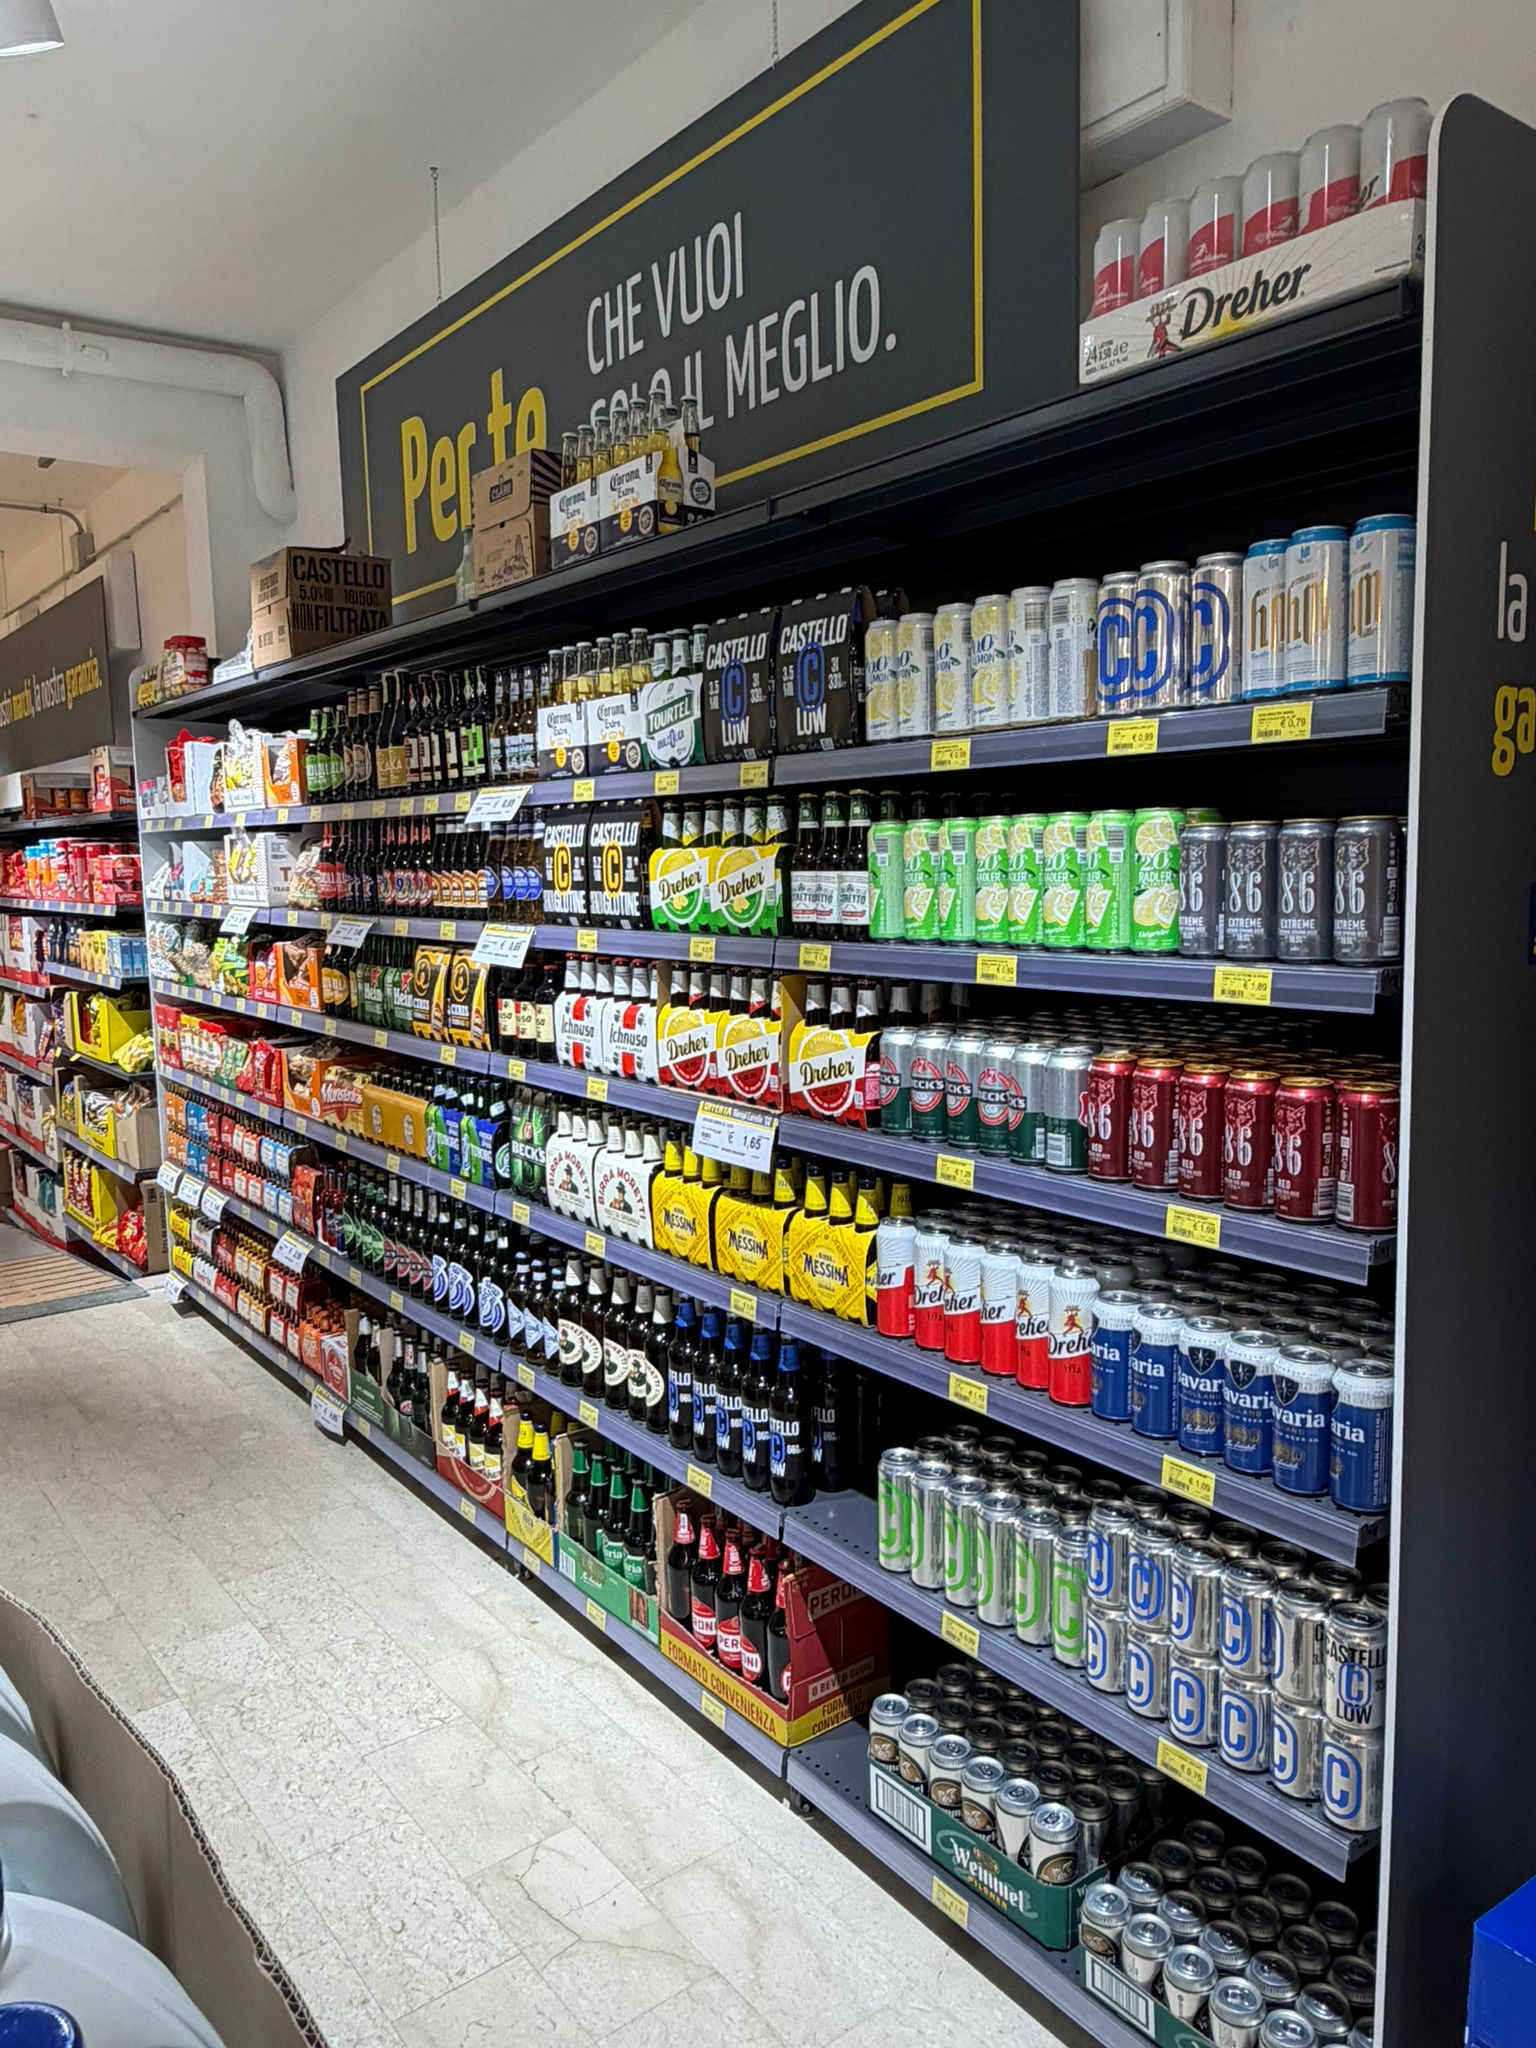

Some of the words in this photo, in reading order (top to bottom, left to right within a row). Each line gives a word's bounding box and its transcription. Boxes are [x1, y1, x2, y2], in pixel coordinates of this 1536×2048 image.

[586, 272, 645, 375] CHE
[651, 211, 744, 338] VUOI
[1179, 261, 1312, 343] Dreher
[725, 264, 898, 418] MEGLIO.
[399, 415, 478, 555] Per
[486, 367, 547, 464] te
[610, 467, 641, 493] Corona
[617, 486, 635, 499] Extra
[559, 490, 586, 513] Corona
[292, 555, 385, 589] CASTELLO
[1497, 541, 1528, 642] la
[315, 605, 388, 635] FILTRATA
[780, 614, 848, 655] CASTELLO
[706, 632, 768, 671] CASTELLO
[597, 704, 626, 721] Corona
[648, 697, 691, 732] TOURTEL
[796, 702, 828, 737] LOW
[721, 715, 750, 747] LOW
[543, 824, 586, 849] CASTELLO
[590, 822, 640, 847] CASTELLO
[658, 870, 703, 900] Dreher
[717, 871, 765, 904] Dreher
[1139, 870, 1172, 883] RADLER
[1228, 917, 1262, 928] EXTREME
[1280, 918, 1315, 930] EXTREME
[666, 1033, 710, 1061] Dreher
[725, 1041, 770, 1071] Dreher
[800, 1057, 855, 1086] Dreher
[511, 1140, 546, 1164] BECK'S
[728, 1131, 735, 1144] €
[743, 1134, 762, 1151] 1,65
[597, 1168, 615, 1206] BIRRA
[663, 1206, 698, 1237] MESSINA
[727, 1227, 769, 1260] MESSINA
[802, 1251, 850, 1288] MESSINA
[667, 1640, 708, 1683] FORMATO
[710, 1673, 777, 1736] CONVENIENZA
[1336, 1697, 1372, 1725] LOW
